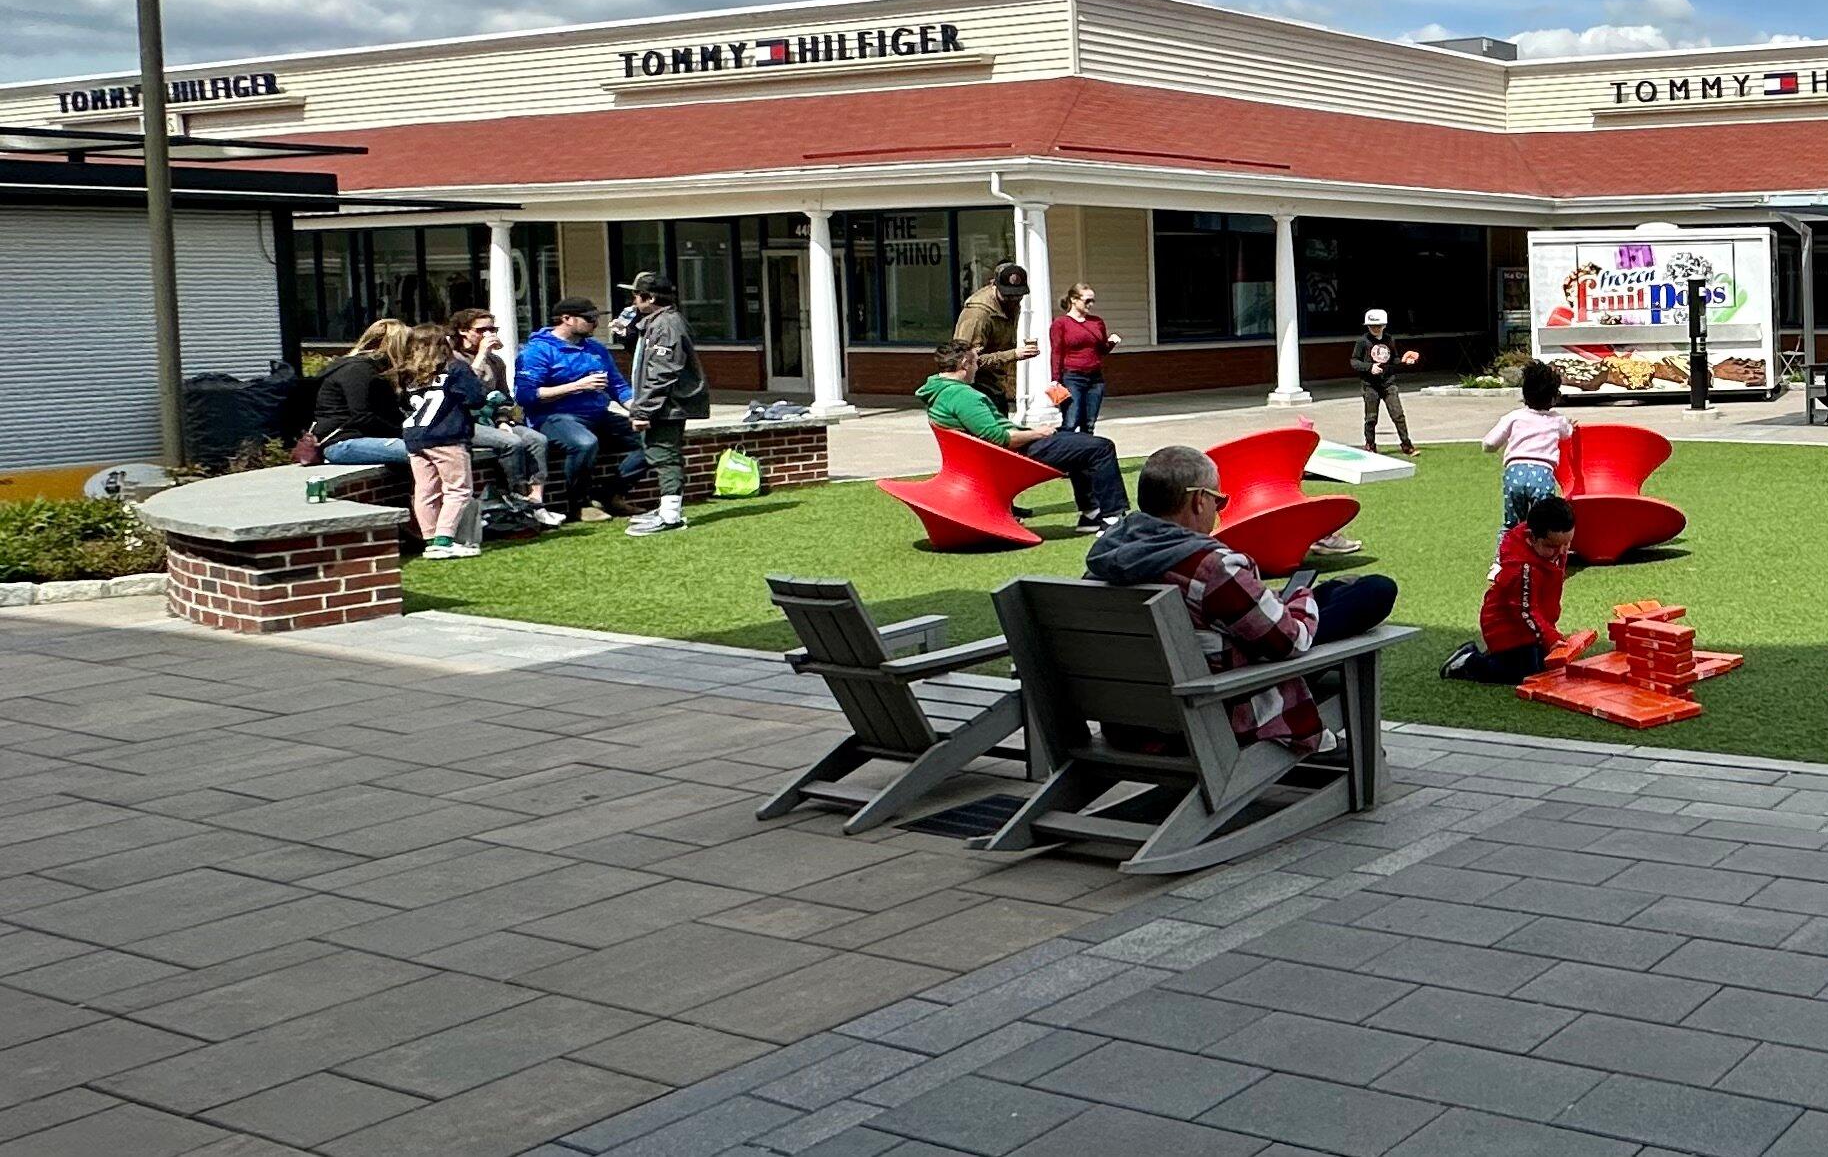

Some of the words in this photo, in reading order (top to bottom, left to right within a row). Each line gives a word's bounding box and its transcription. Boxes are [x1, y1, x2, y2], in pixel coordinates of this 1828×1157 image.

[618, 41, 748, 78] TOMMY
[797, 23, 964, 64] HILFIGER
[57, 83, 143, 114] TOMMY
[171, 72, 283, 104] HILFIGER
[1609, 74, 1750, 104] TOMMY
[884, 216, 917, 239] THE
[884, 242, 942, 267] CHINO
[1600, 269, 1656, 289] frozen
[1577, 278, 1645, 323] fruit
[402, 389, 445, 429] 27
